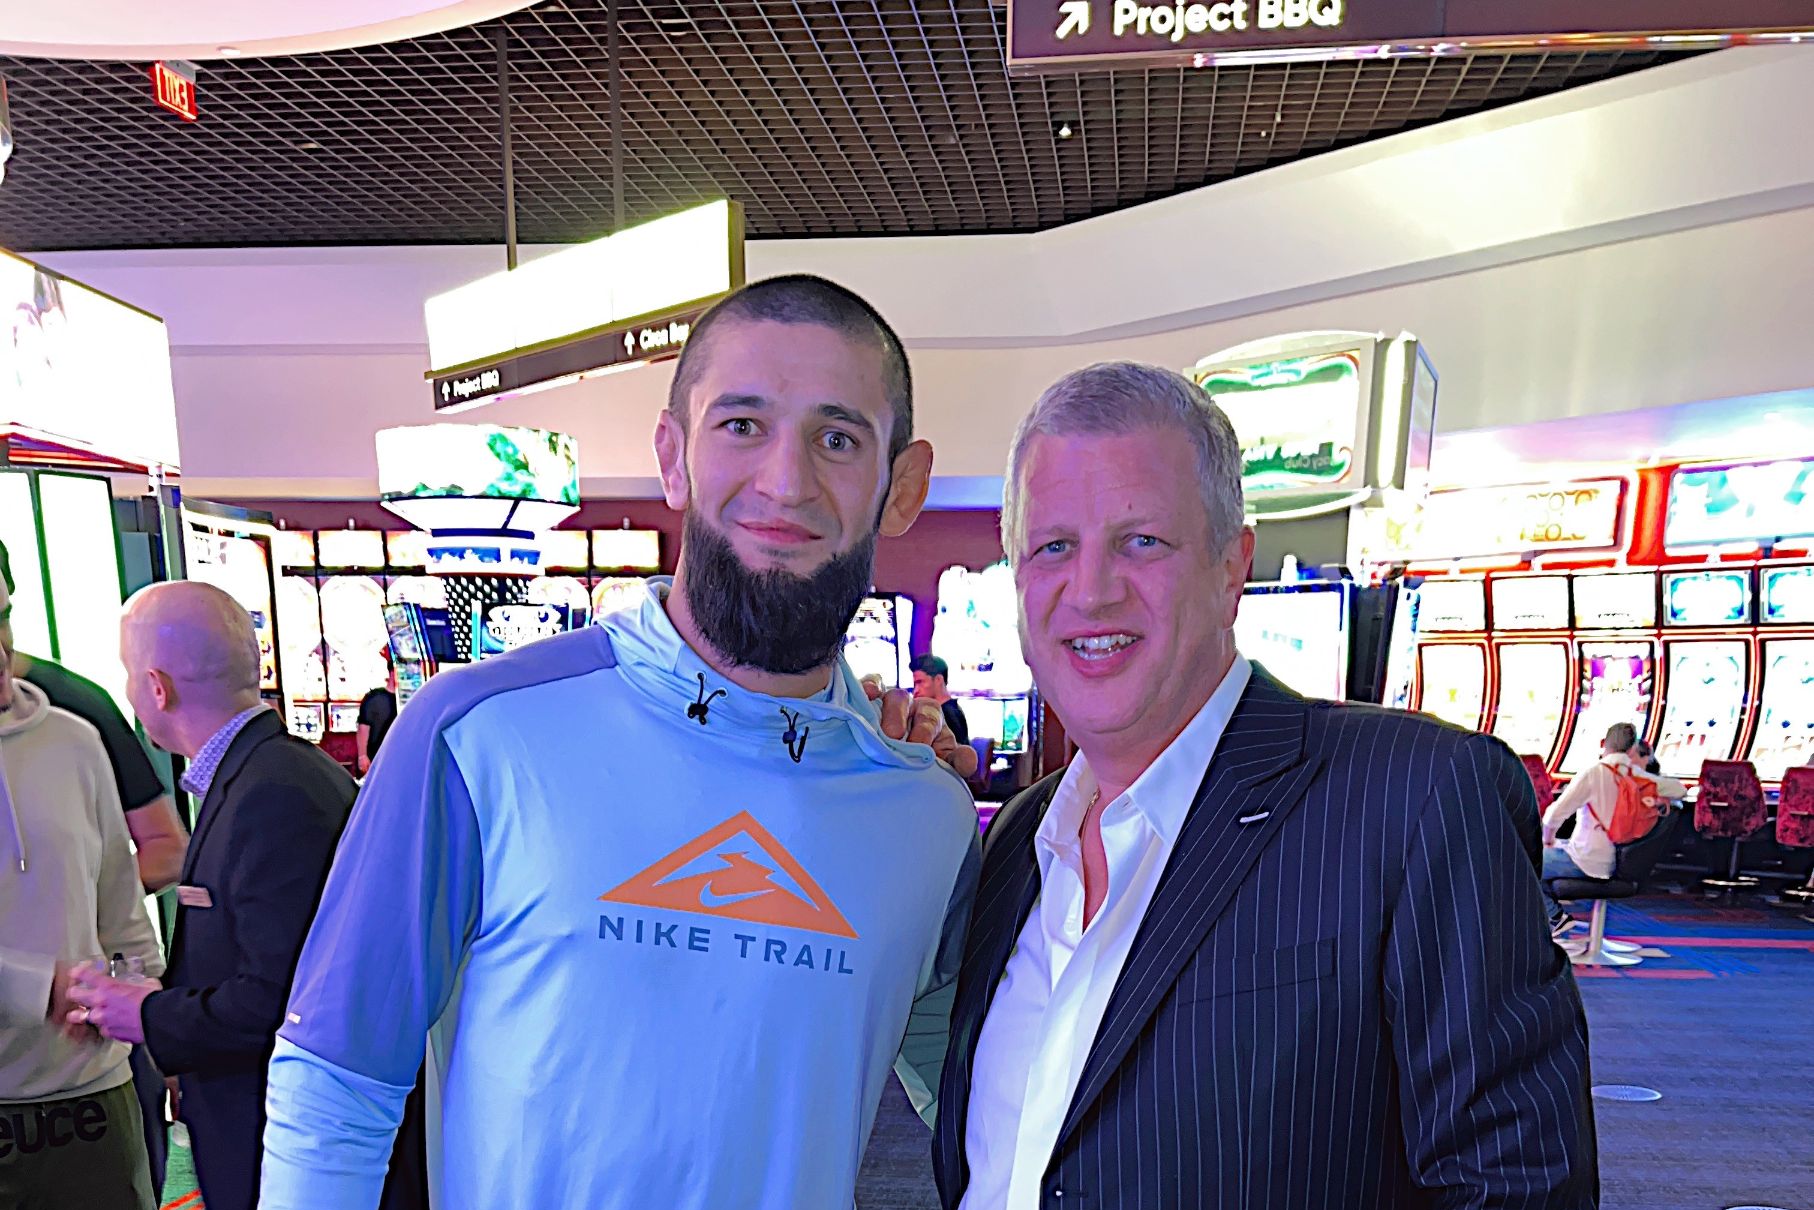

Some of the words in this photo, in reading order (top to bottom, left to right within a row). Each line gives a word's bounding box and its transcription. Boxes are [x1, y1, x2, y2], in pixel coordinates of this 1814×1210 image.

[1113, 0, 1248, 42] Project
[1257, 0, 1341, 30] BBQ
[598, 914, 711, 953] NIKE
[734, 933, 854, 975] TRAIL
